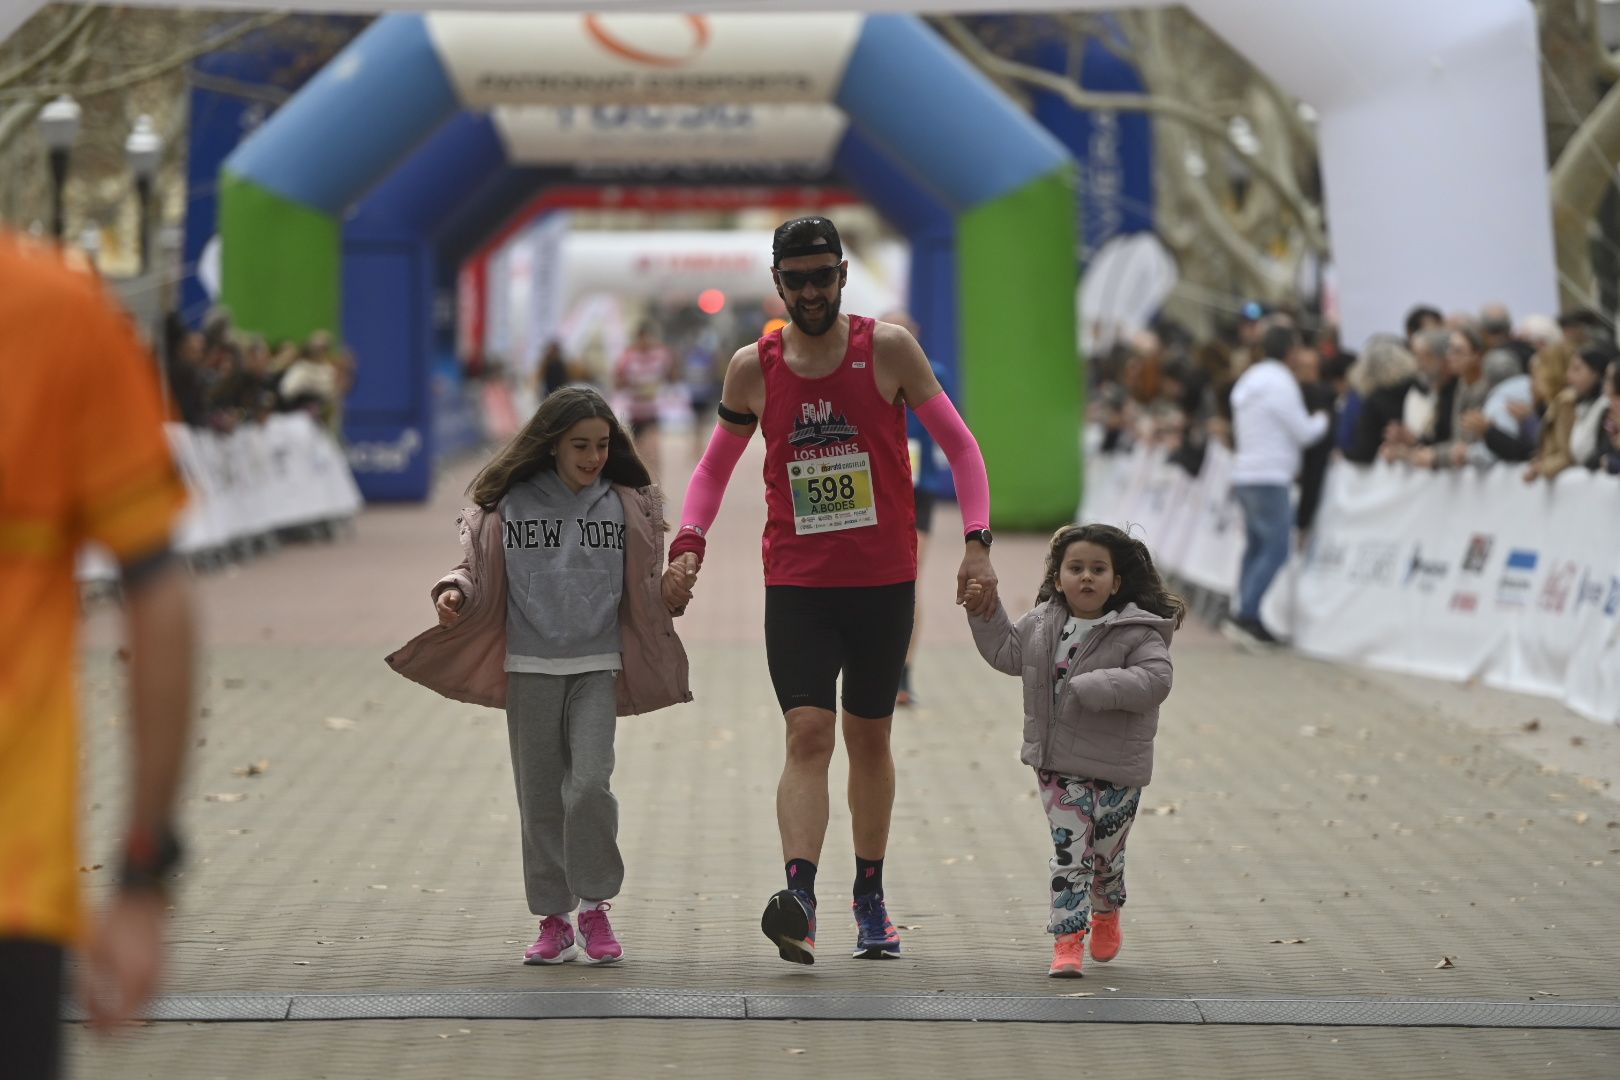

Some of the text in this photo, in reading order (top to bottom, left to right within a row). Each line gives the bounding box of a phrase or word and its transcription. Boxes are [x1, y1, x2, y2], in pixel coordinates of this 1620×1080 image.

[794, 442, 859, 460] LOS LUNES
[807, 474, 855, 504] 598
[811, 500, 856, 515] A.BODES
[506, 518, 625, 550] NEW YORK
